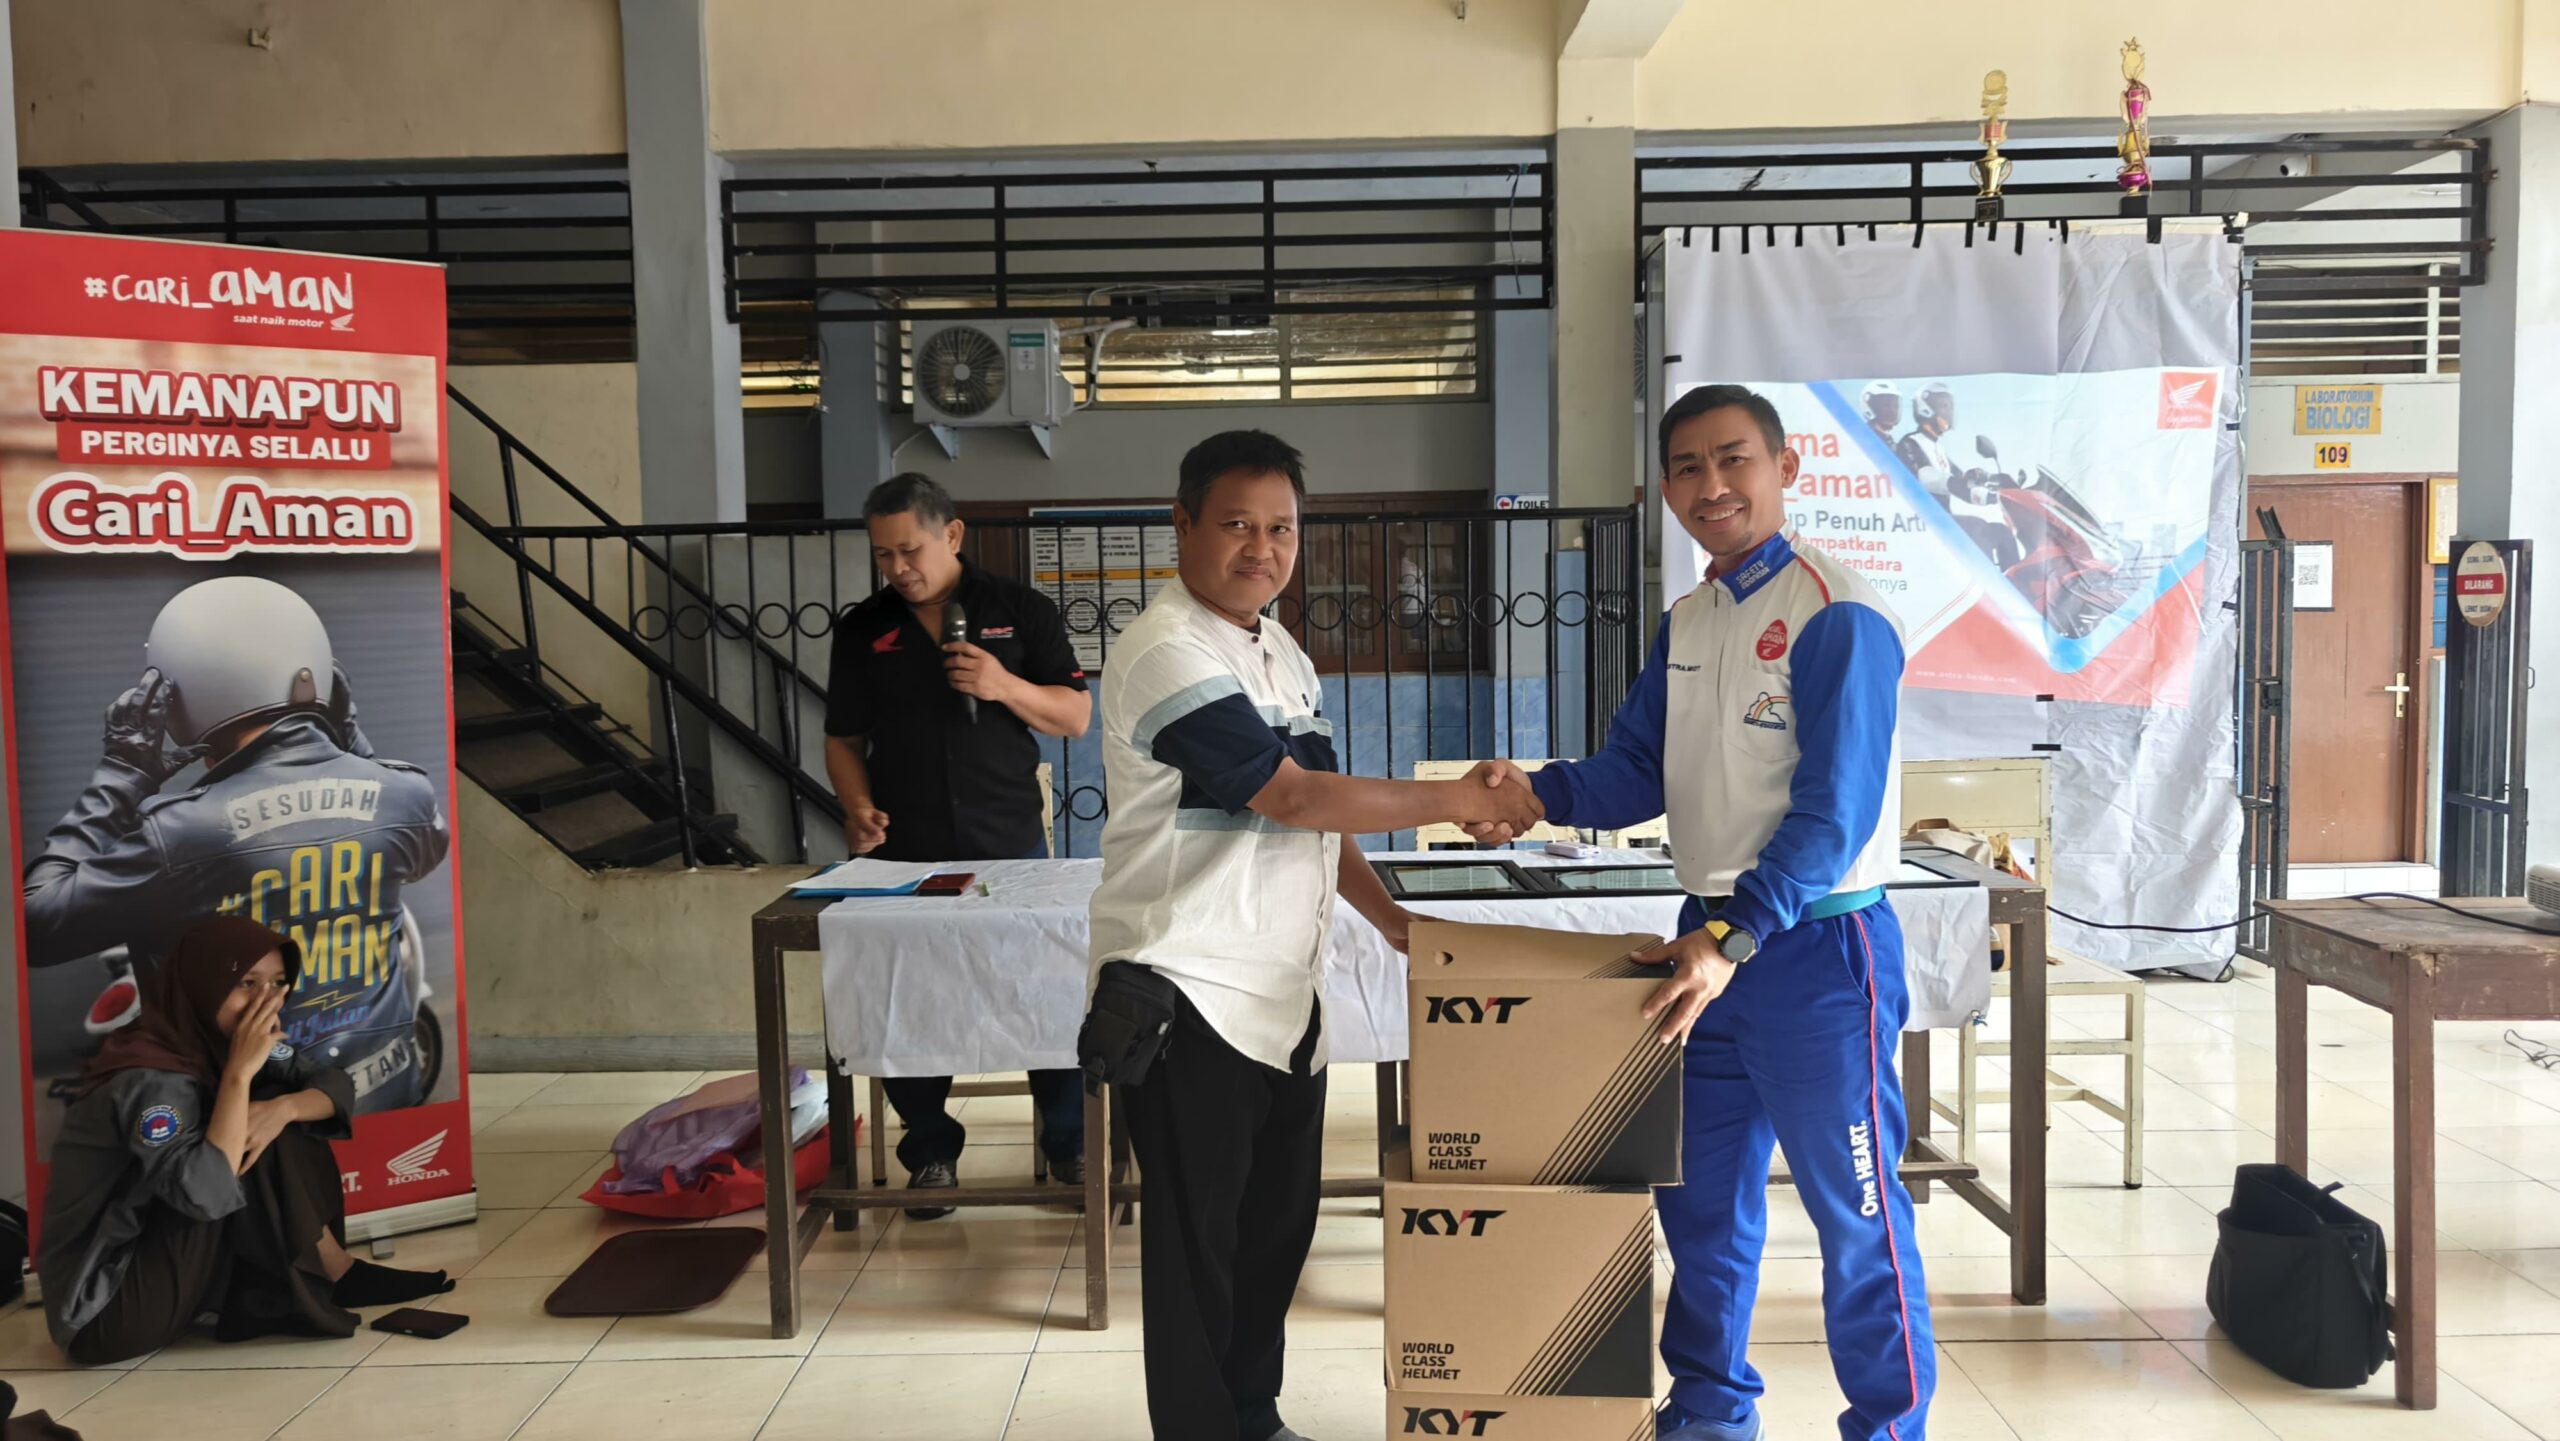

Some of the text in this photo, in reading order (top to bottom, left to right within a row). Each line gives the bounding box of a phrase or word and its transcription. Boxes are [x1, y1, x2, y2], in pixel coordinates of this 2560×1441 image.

[233, 313, 324, 328] saat naik motor
[41, 369, 397, 425] KEMANAPUN
[2304, 390, 2374, 403] LABORATORIUM
[2306, 405, 2371, 430] BIOLOGI
[81, 430, 371, 461] PERGINYA SELALU
[2318, 446, 2348, 464] 109
[48, 487, 408, 545] Cari_Aman
[1815, 510, 1885, 532] Penuh
[2464, 579, 2494, 590] DILARANG
[233, 787, 377, 830] SESUDAH
[216, 840, 384, 926] #CARI
[270, 914, 393, 992] MAN
[1425, 996, 1533, 1024] KYT
[1427, 1132, 1481, 1145] WORLD
[1427, 1145, 1472, 1158] CLASS
[1427, 1158, 1487, 1171] HELMET
[1849, 1120, 1879, 1217] One HEART.
[387, 1168, 451, 1186] HONDA
[1400, 1208, 1508, 1237] KYT
[1402, 1342, 1454, 1355] WORLD
[1402, 1355, 1446, 1367] CLASS
[1402, 1367, 1461, 1380] HELMET
[1402, 1406, 1508, 1437] KYT
